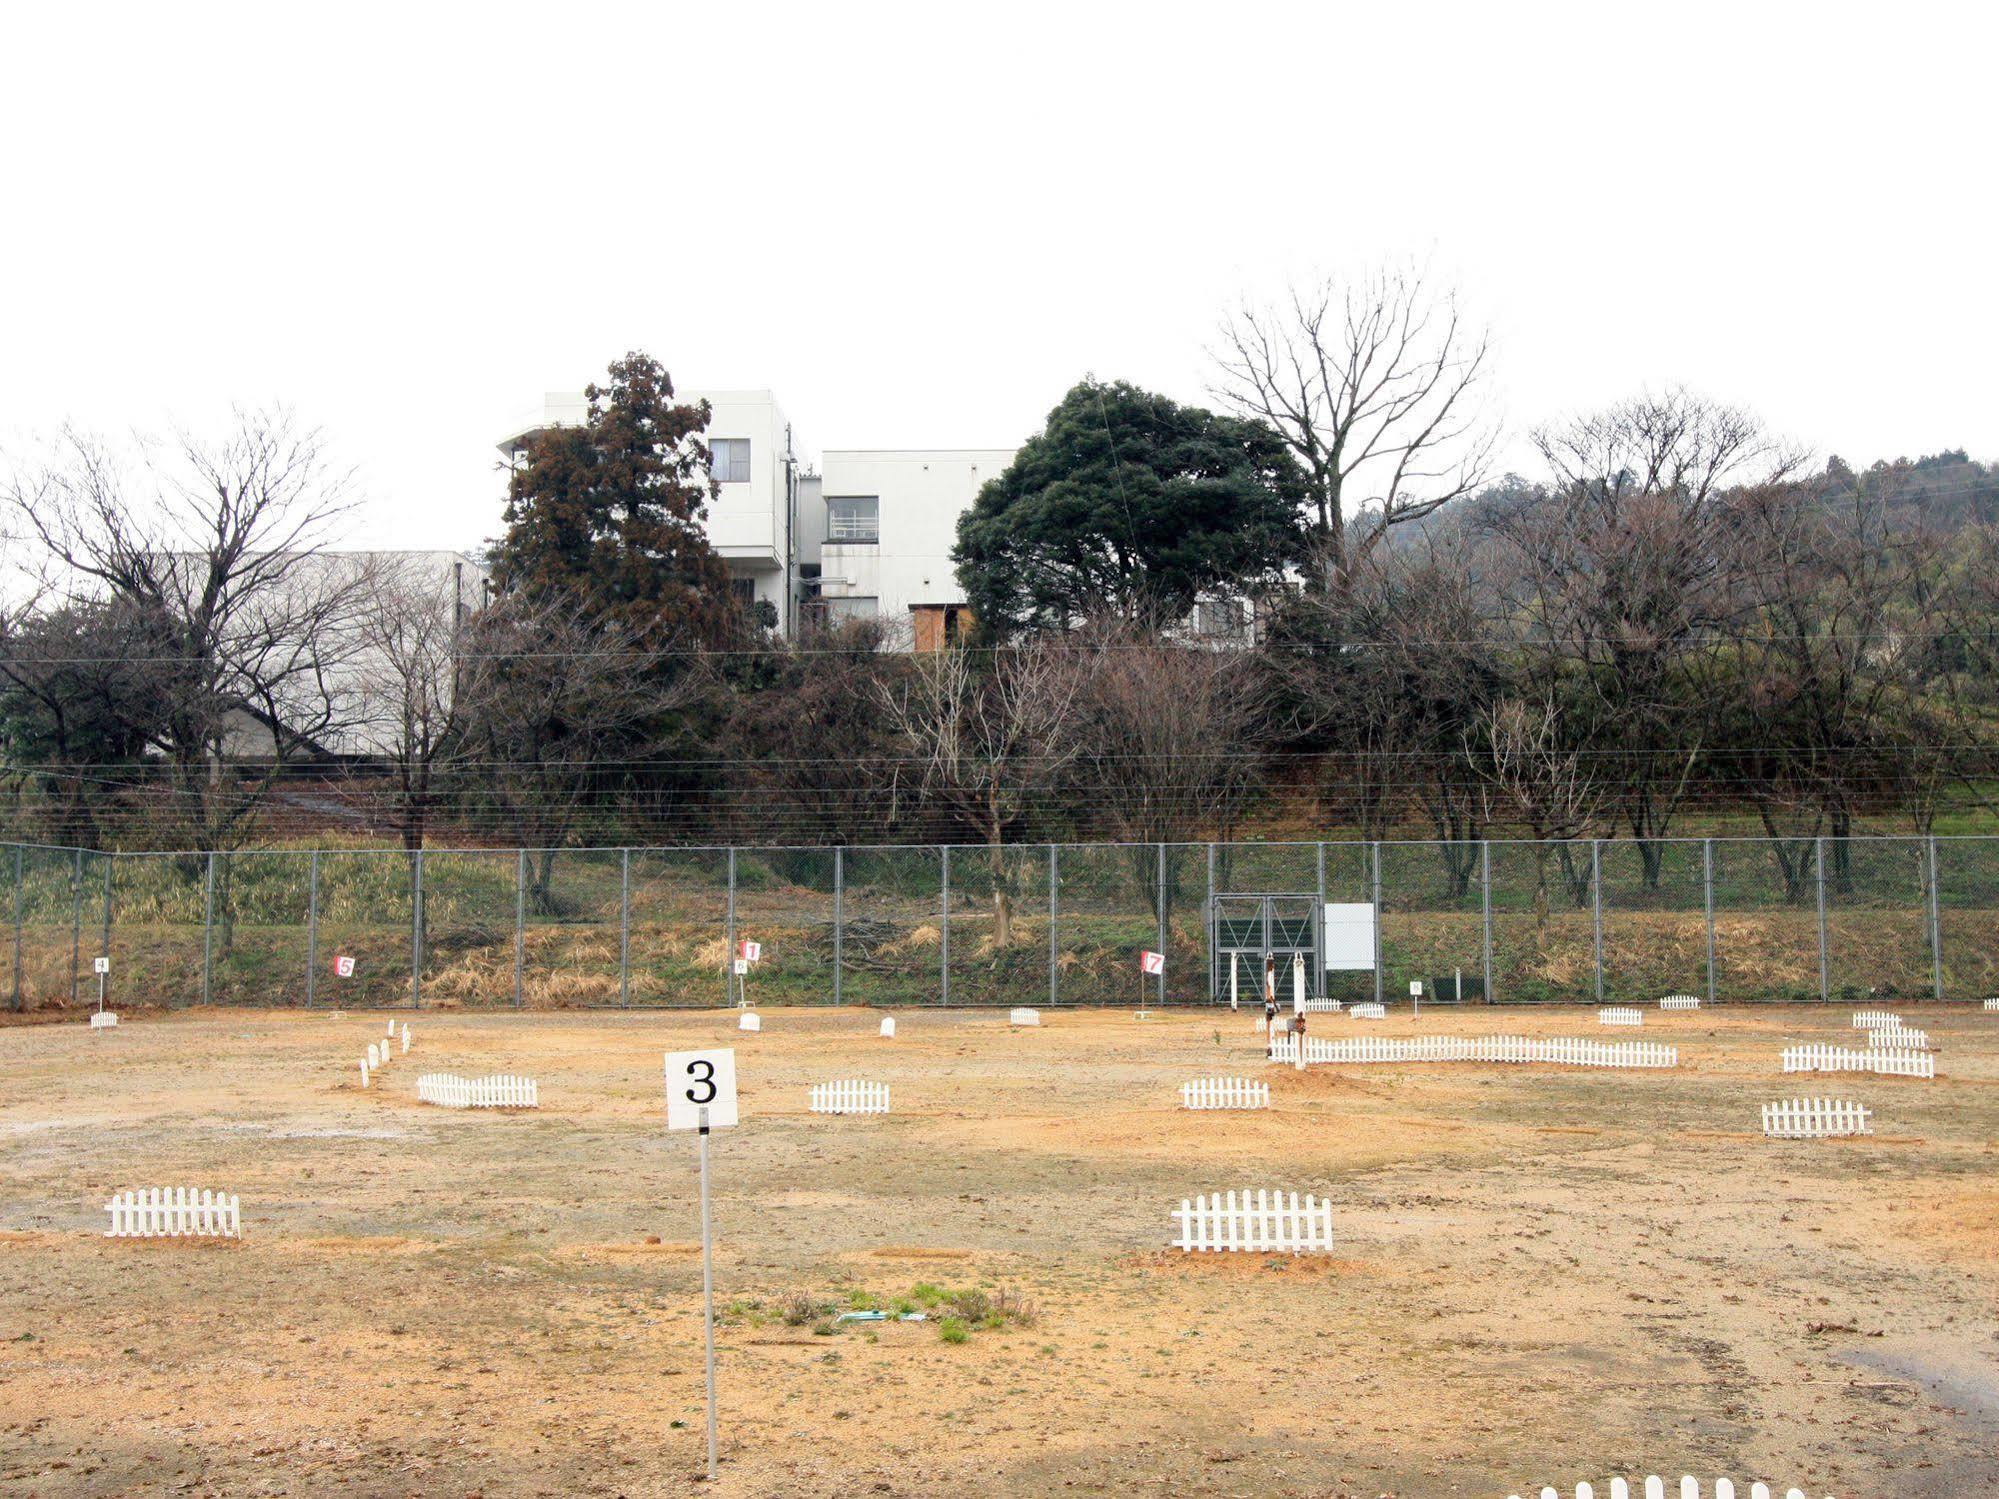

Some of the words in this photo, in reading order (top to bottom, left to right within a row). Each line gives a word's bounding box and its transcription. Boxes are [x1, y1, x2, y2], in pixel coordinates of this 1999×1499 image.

[341, 960, 352, 974] 5
[1150, 955, 1162, 970] 7
[686, 1060, 717, 1104] 3
